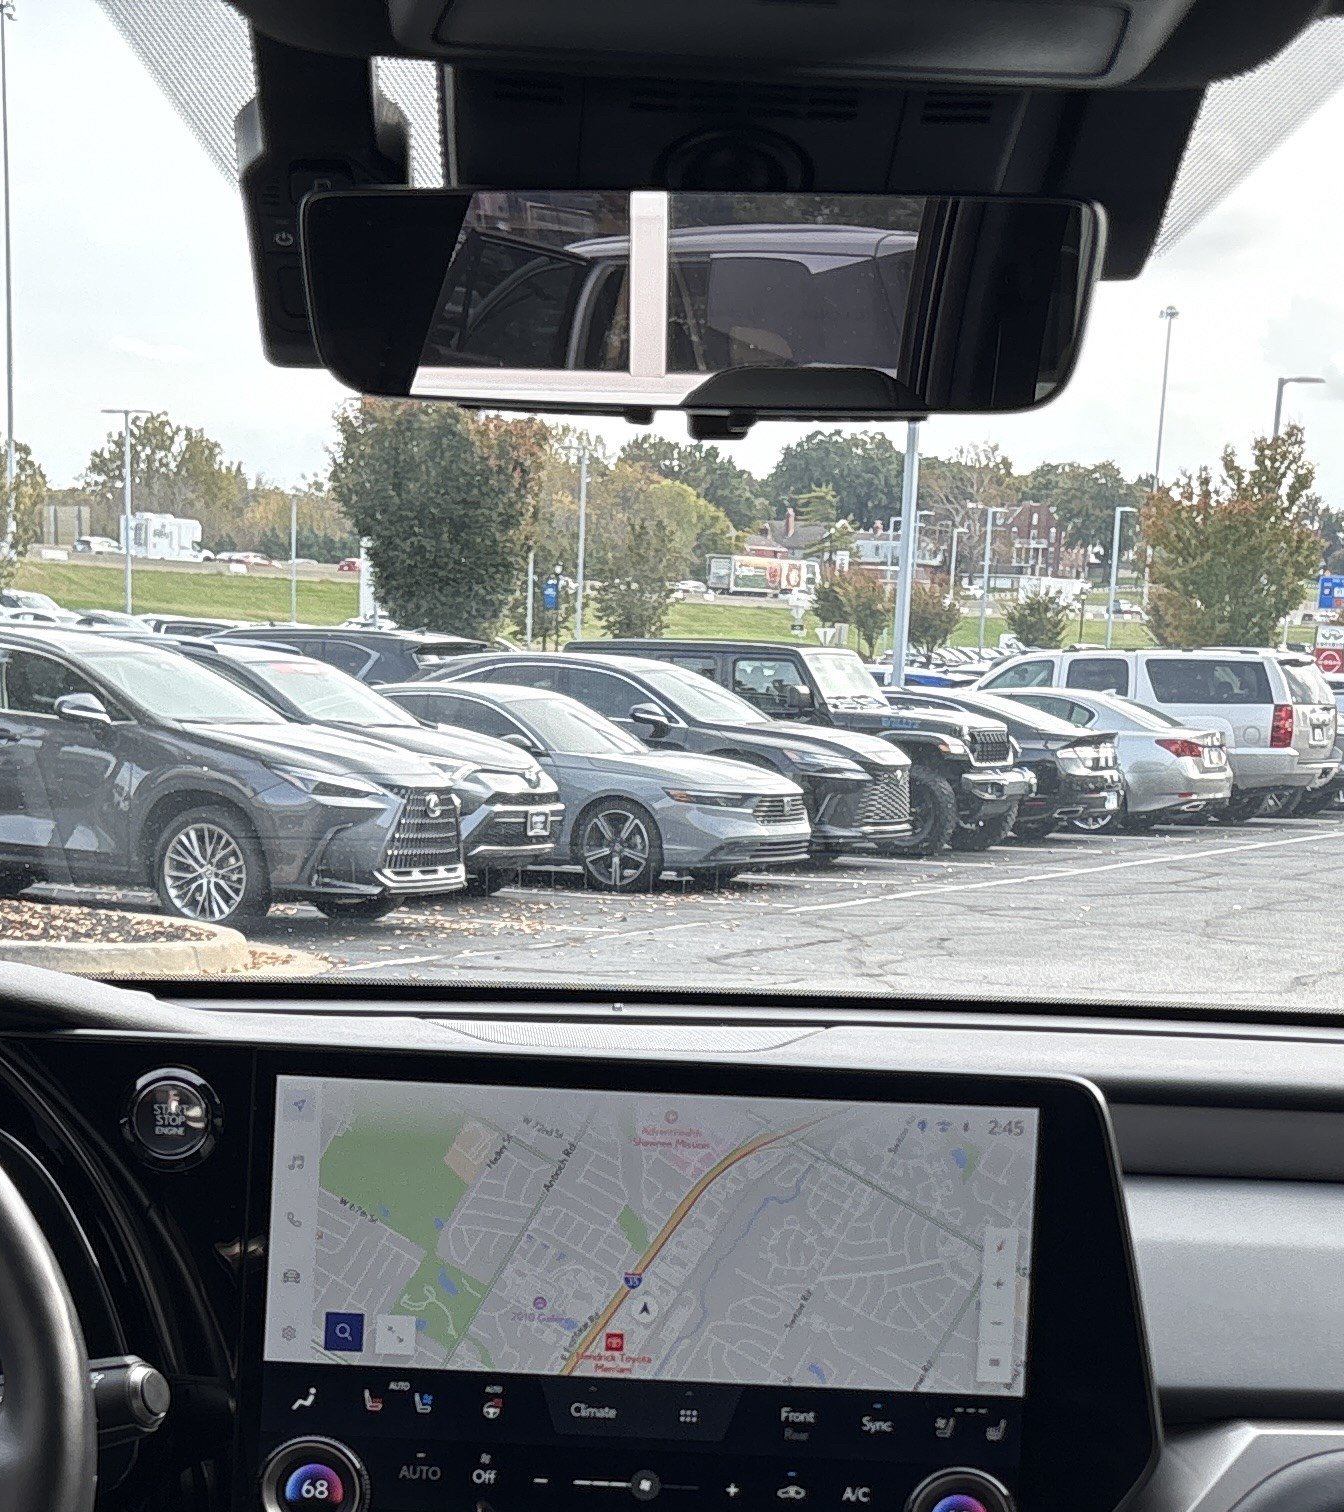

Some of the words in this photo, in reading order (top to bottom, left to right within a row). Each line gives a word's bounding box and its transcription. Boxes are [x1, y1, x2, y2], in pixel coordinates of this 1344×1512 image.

[156, 1115, 186, 1126] STOP
[988, 1119, 1025, 1136] 2:45
[388, 1381, 411, 1391] AUTO
[570, 1402, 617, 1420] Climate
[780, 1406, 815, 1423] Front
[861, 1416, 894, 1434] Sync
[399, 1465, 441, 1481] AUTO
[472, 1469, 498, 1484] Off
[301, 1479, 329, 1499] 68
[842, 1486, 871, 1502] A/C
